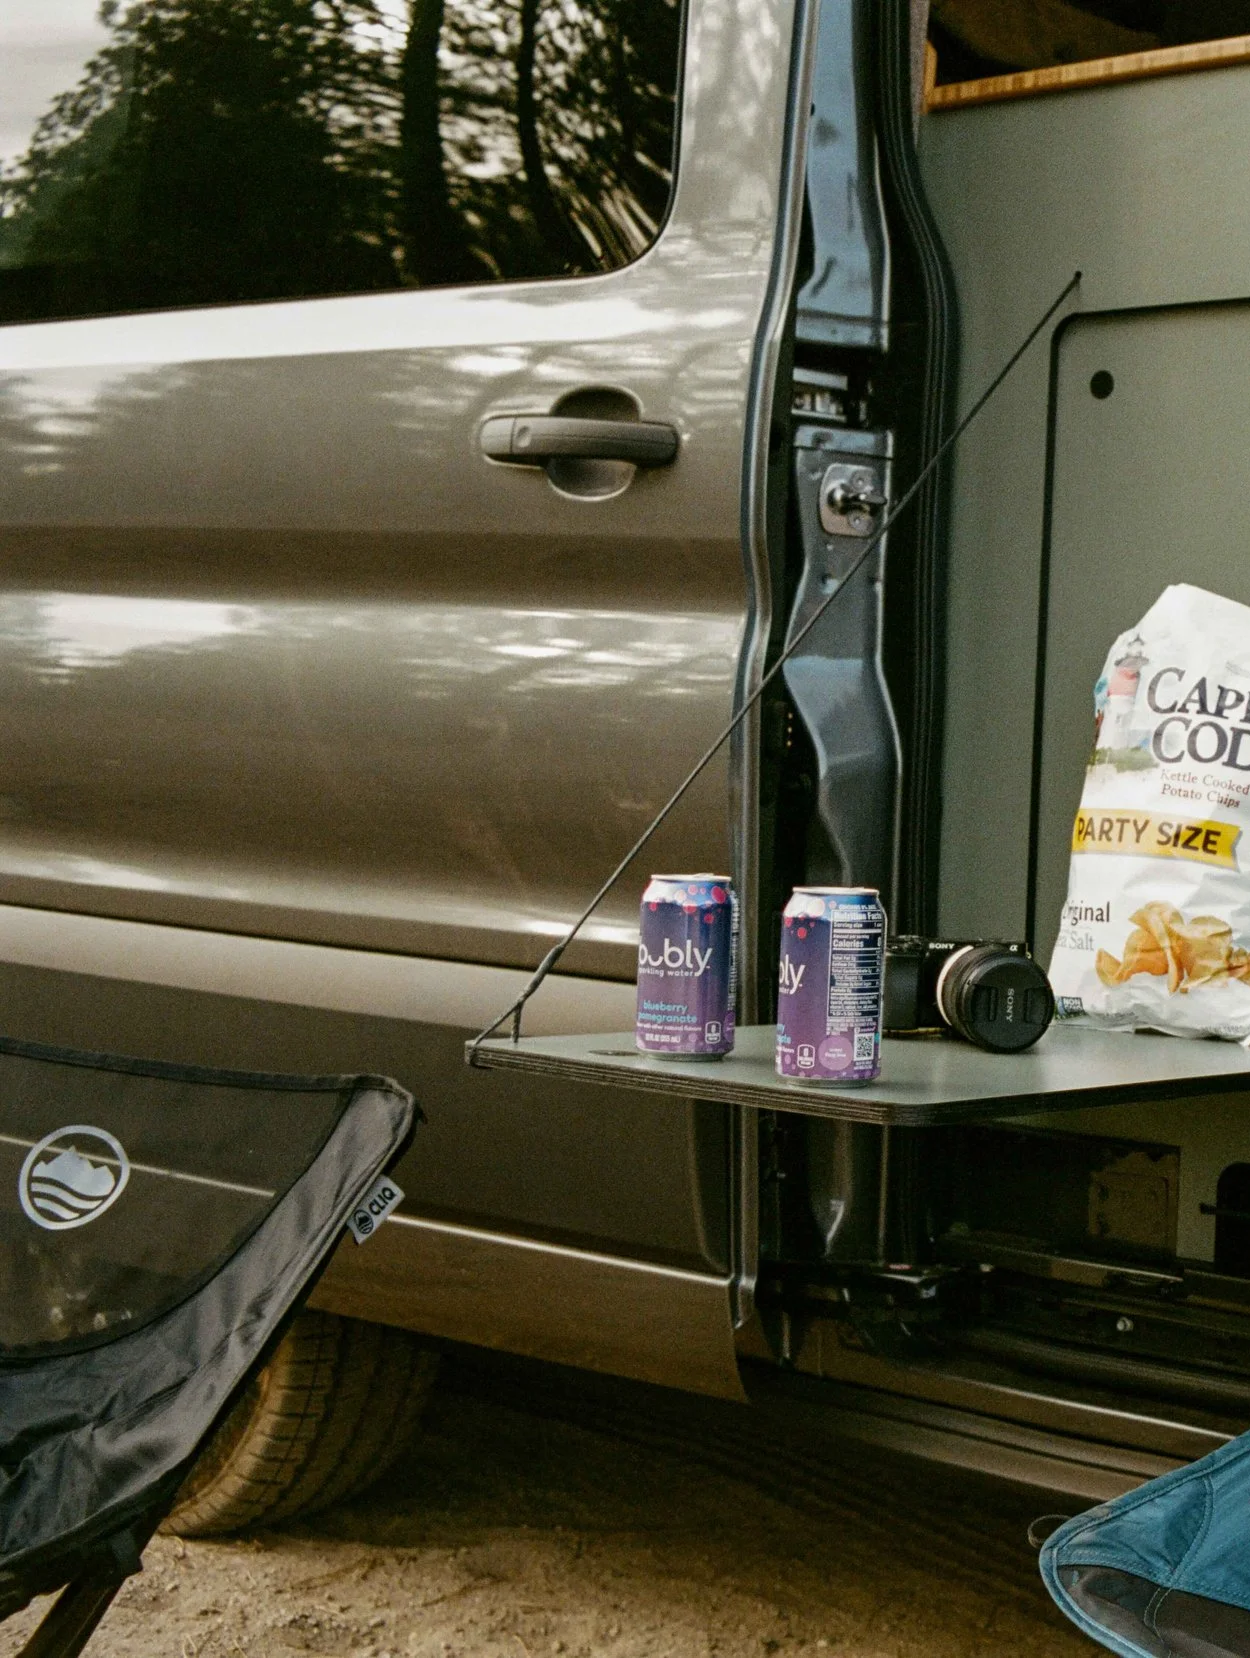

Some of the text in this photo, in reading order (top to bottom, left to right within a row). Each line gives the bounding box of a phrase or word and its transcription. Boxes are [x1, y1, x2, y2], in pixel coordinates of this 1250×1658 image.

[1160, 769, 1250, 796] Kettle Cooked
[1161, 783, 1241, 808] Potato Chips
[1076, 817, 1222, 855] PARTY SIZE
[832, 939, 864, 948] Calories
[643, 999, 689, 1015] blueberry
[1006, 988, 1015, 1023] SONY
[368, 1187, 397, 1215] CLIQ
